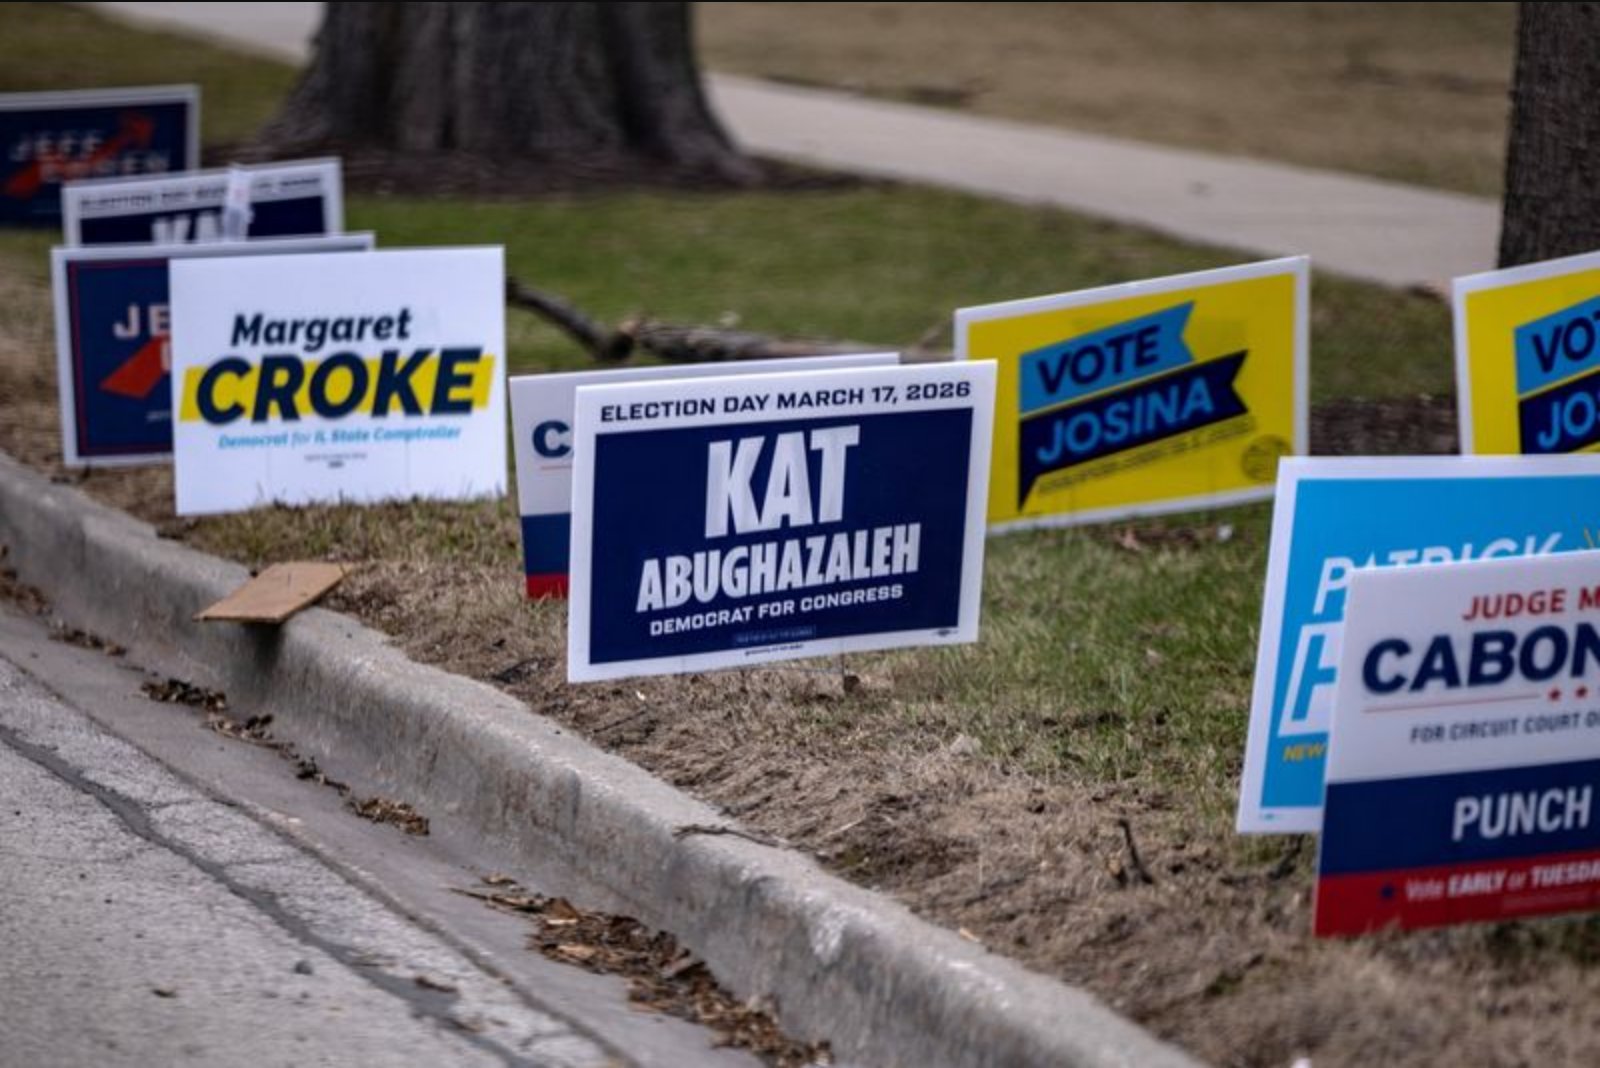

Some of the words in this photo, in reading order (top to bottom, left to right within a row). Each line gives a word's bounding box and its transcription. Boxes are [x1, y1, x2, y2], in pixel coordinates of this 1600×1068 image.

[113, 303, 170, 338] JE
[231, 308, 412, 352] Margaret
[1532, 310, 1600, 373] VO
[197, 345, 483, 425] CROKE
[1036, 324, 1162, 394] VOTE
[600, 397, 716, 423] ELECTION
[723, 394, 770, 414] DAY
[777, 387, 864, 410] MARCH
[871, 385, 899, 405] 17,
[906, 381, 972, 401] 2026
[1036, 376, 1215, 464] JOSINA
[1537, 388, 1600, 449] JO
[218, 432, 288, 449] Democrat
[291, 431, 311, 446] for
[314, 430, 327, 443] IL
[331, 427, 370, 443] State
[373, 425, 462, 442] Comptroller
[532, 420, 574, 458] C
[704, 424, 861, 539] KAT
[635, 522, 922, 613] ABUGHAZALEH
[649, 605, 754, 636] DEMOCRAT
[758, 600, 795, 620] FOR
[800, 584, 904, 612] CONGRESS
[1462, 588, 1567, 621] JUDGE
[1410, 725, 1445, 744] FOR
[1450, 717, 1519, 742] CIRCUIT
[1524, 712, 1581, 734] COURT
[1585, 709, 1600, 728] O
[1451, 785, 1593, 842] PUNCH
[1405, 878, 1445, 900] Vote
[1448, 868, 1507, 898] EARLY
[1507, 872, 1527, 890] or
